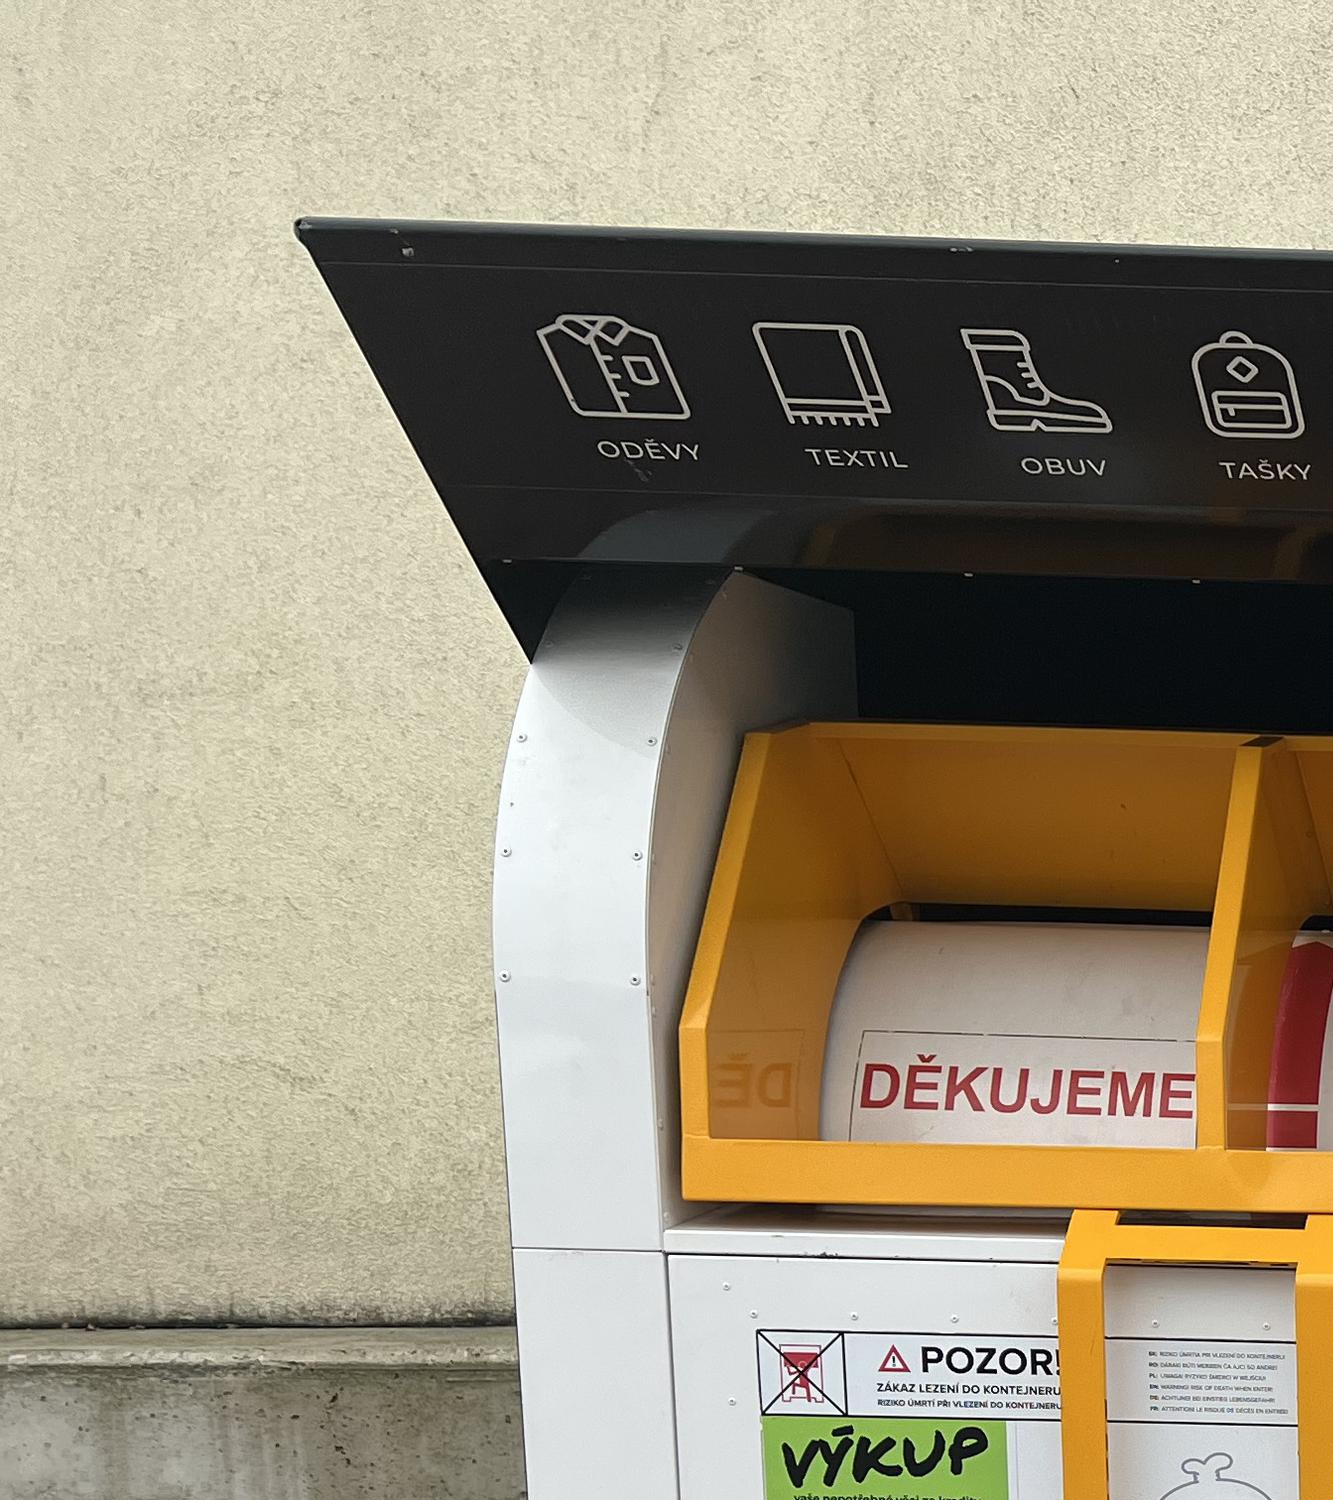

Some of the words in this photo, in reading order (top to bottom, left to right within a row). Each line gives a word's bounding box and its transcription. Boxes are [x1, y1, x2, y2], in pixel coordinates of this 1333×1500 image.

[596, 436, 701, 464] ODĚVY
[806, 447, 908, 470] TEXTIL
[1020, 455, 1107, 479] OBUV
[1218, 458, 1312, 483] TAŠKY
[860, 1053, 1197, 1119] DĚKUJEME
[877, 1381, 915, 1393] ZÁKAZ
[919, 1382, 959, 1395] LEZENÍ
[962, 1385, 980, 1395] DO
[990, 1401, 1004, 1410] DO
[781, 1425, 989, 1489] VÝKUP
